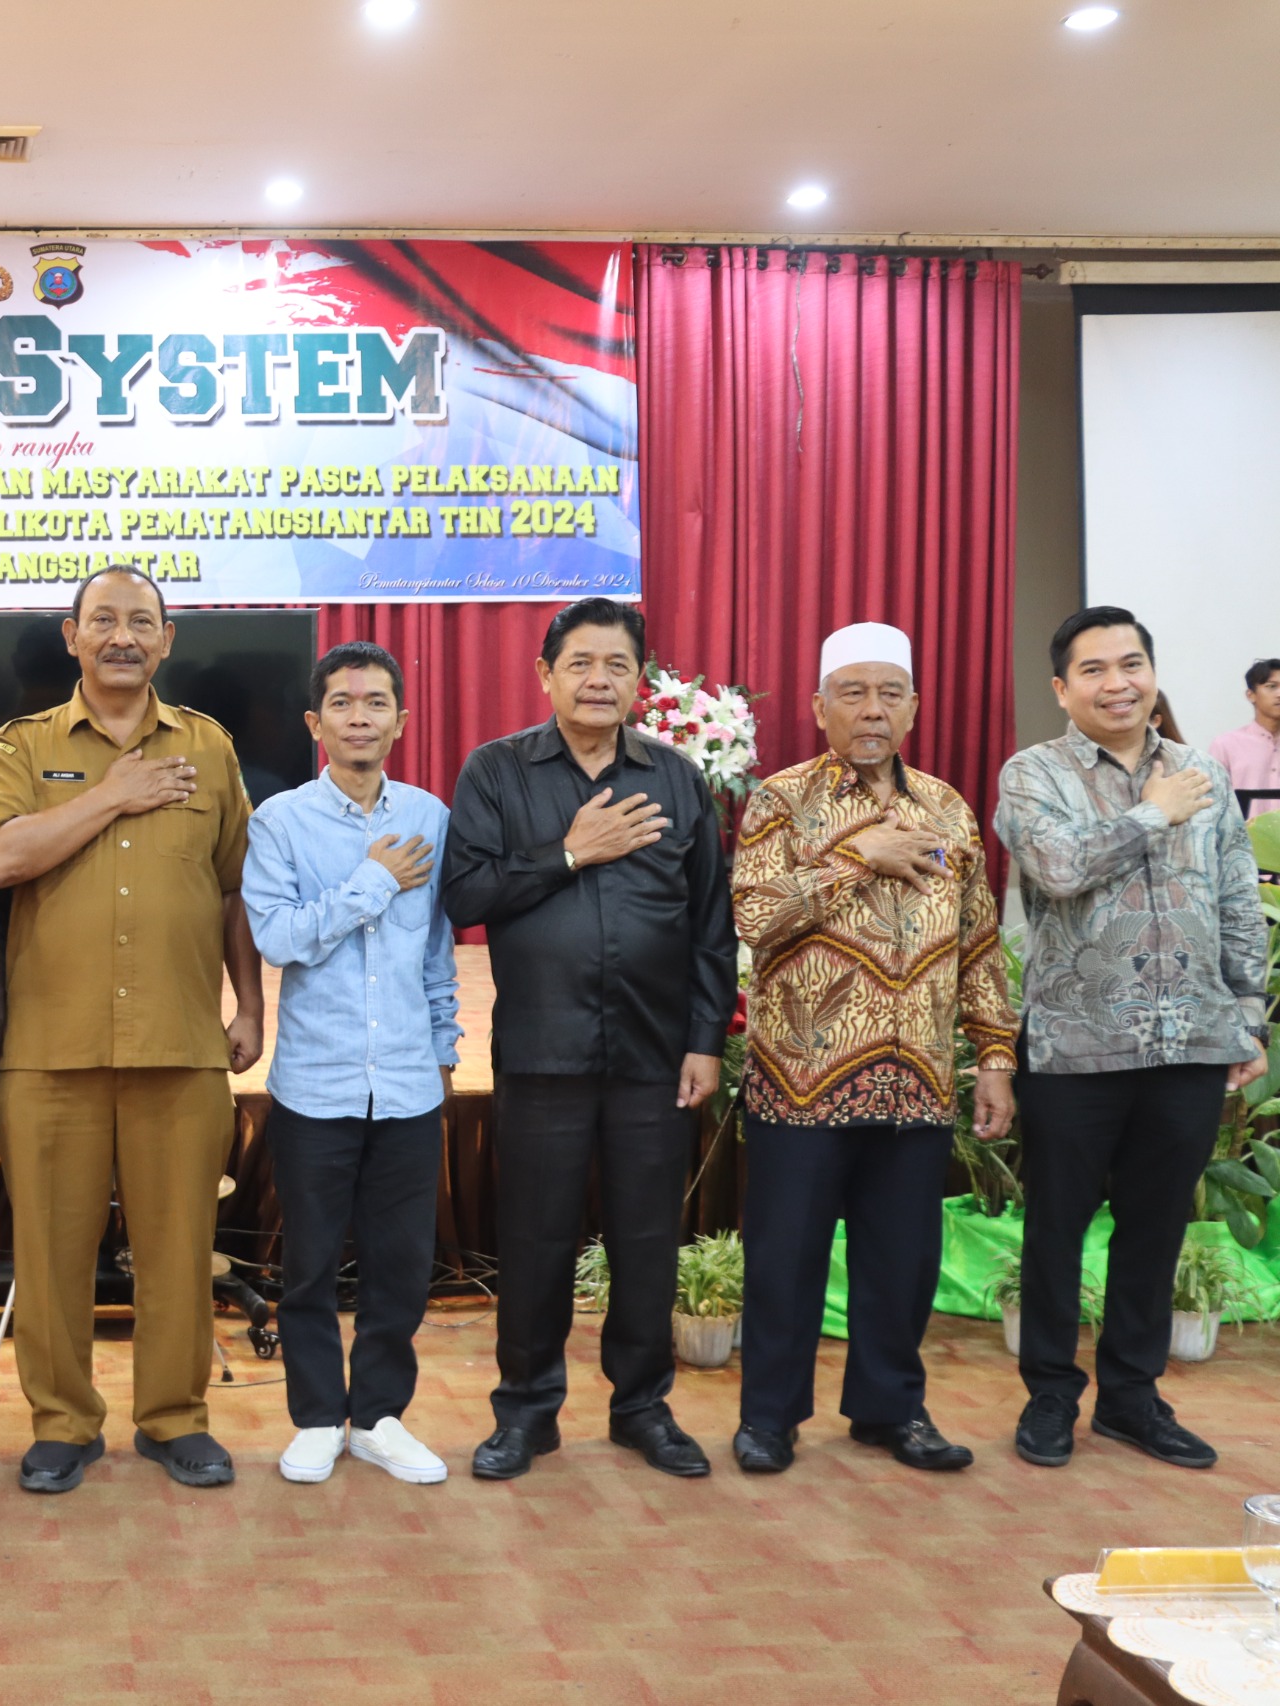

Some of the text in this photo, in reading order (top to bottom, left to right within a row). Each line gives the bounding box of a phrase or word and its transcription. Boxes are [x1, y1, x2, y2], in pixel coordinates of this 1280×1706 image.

[32, 244, 84, 254] SUMATERA UTARA
[11, 431, 95, 470] rangka
[41, 465, 272, 497] MASYARAKAT
[280, 465, 384, 495] PASCA
[391, 464, 620, 494] PELAKSANAAN
[121, 506, 431, 537] PEMATANGSIANTAR
[438, 506, 502, 535] THN
[510, 500, 597, 535] 2024
[359, 571, 462, 596] Pematangsiantar
[511, 573, 532, 589] 10
[593, 573, 632, 588] 2024
